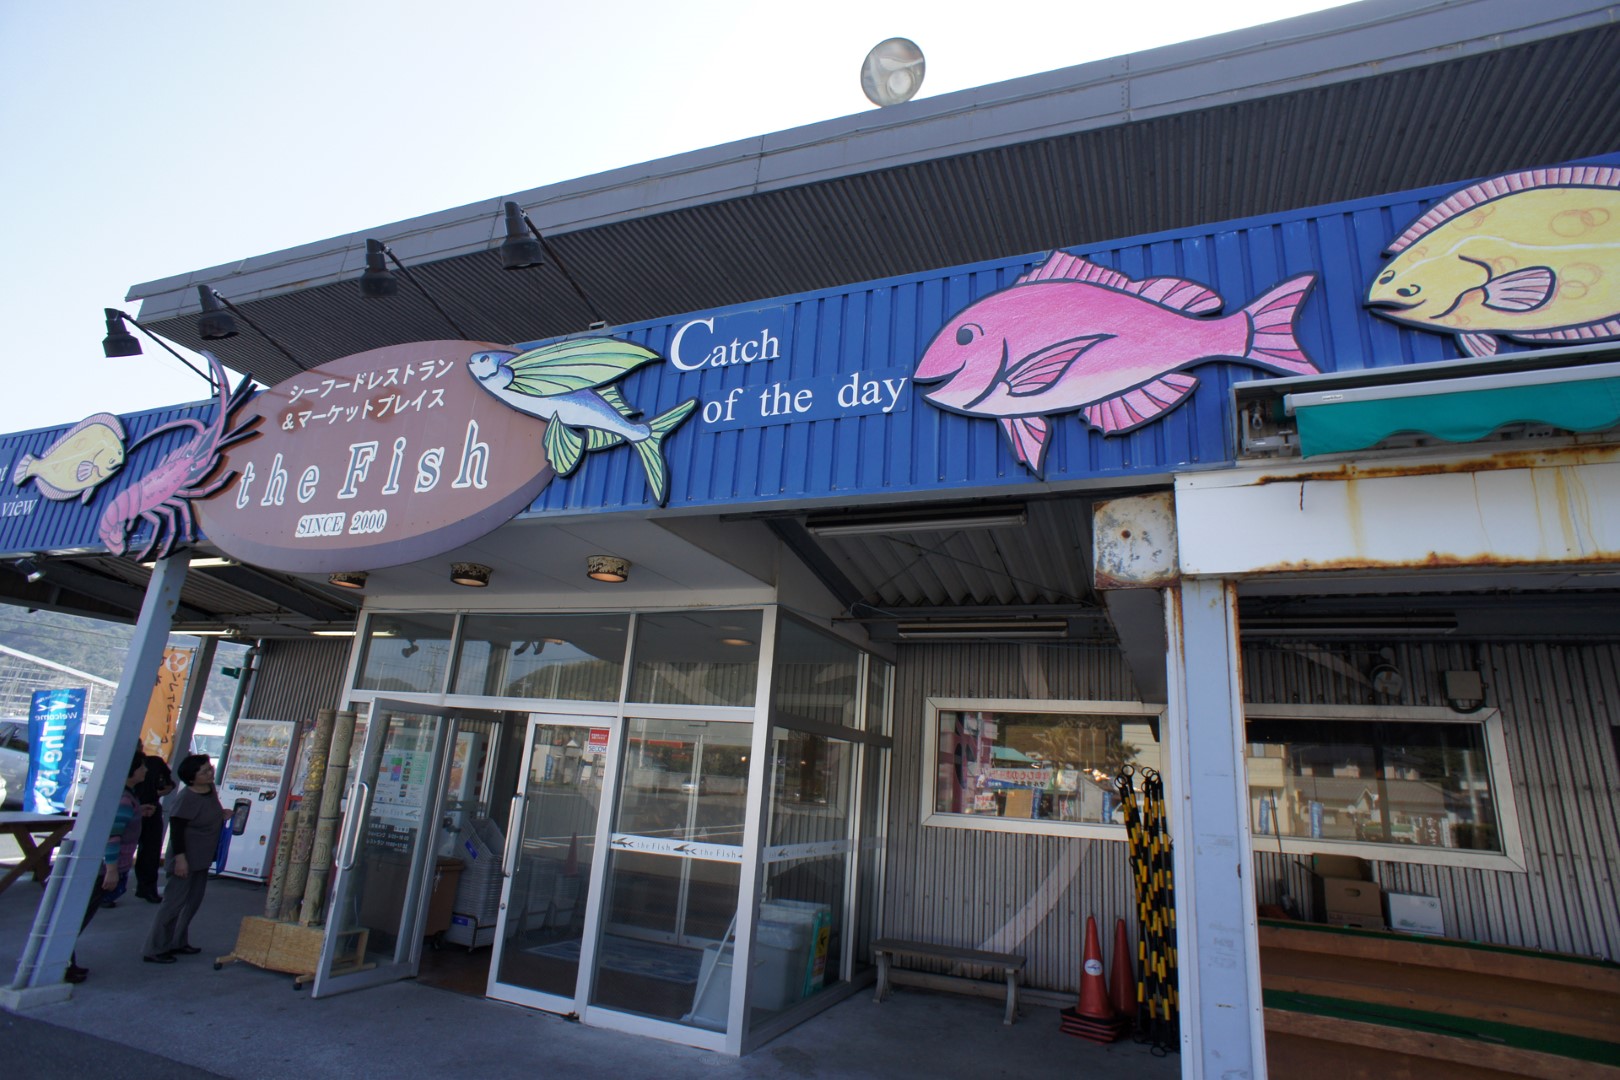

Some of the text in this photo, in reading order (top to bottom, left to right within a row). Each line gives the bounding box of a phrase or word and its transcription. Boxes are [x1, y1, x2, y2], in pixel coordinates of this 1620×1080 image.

[670, 317, 781, 372] Catch
[288, 359, 454, 404] シーフードレストラン
[281, 388, 445, 431] &マーケットプレイス
[702, 372, 909, 424] of the day
[0, 464, 9, 482] t
[236, 419, 490, 509] the Fish
[2, 494, 38, 517] view
[295, 509, 388, 537] SINCE 2000
[588, 745, 607, 753] SECOM
[651, 843, 671, 851] Fish
[716, 850, 736, 859] Fish
